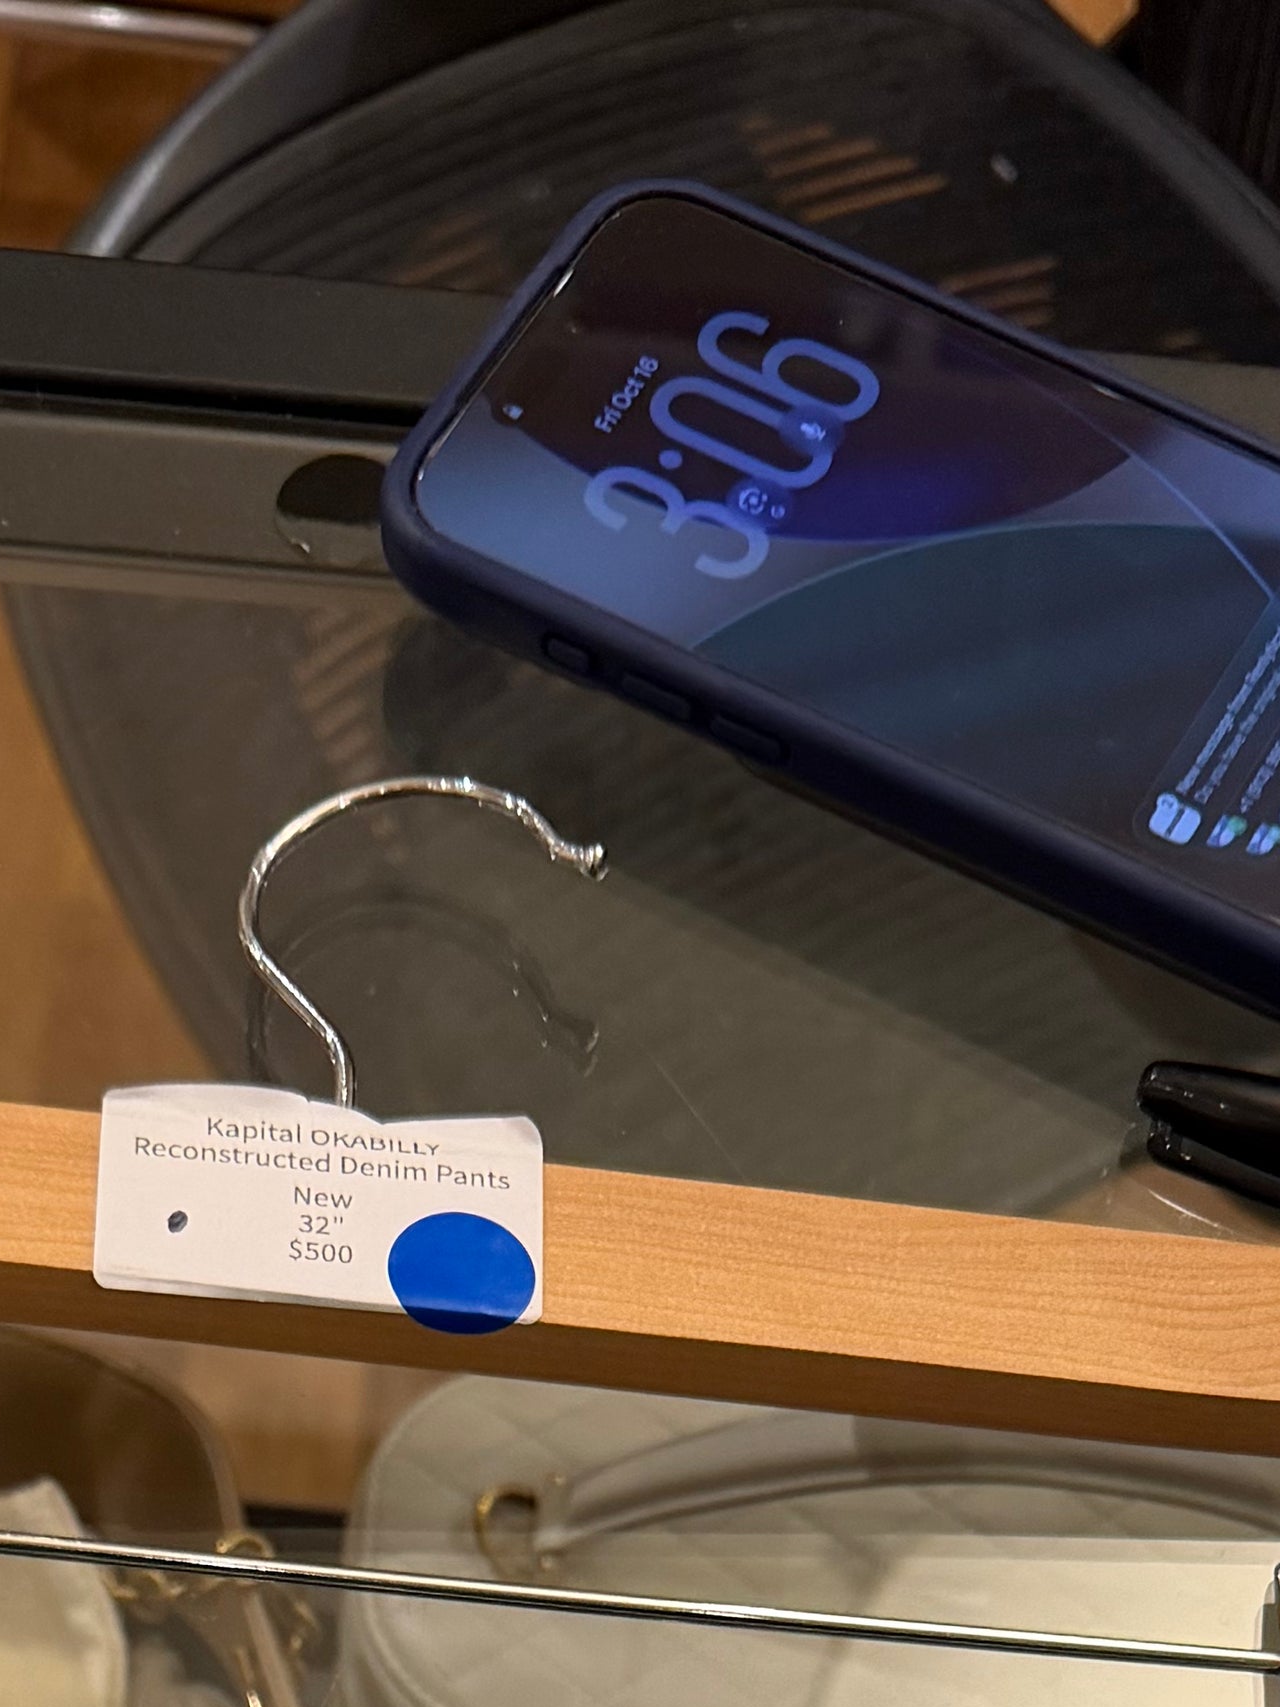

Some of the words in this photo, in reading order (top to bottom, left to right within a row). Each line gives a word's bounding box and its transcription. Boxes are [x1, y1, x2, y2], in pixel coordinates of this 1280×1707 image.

[593, 404, 622, 435] Fri
[609, 373, 646, 413] Oct
[583, 310, 880, 580] 3:06
[207, 1117, 301, 1144] Kapital
[311, 1128, 440, 1156] OKABILLY
[134, 1136, 331, 1173] Reconstructed
[341, 1156, 427, 1181] Denim
[437, 1164, 511, 1190] Pants
[294, 1186, 352, 1209] New
[298, 1214, 343, 1236] 32"
[288, 1237, 353, 1263] $500
